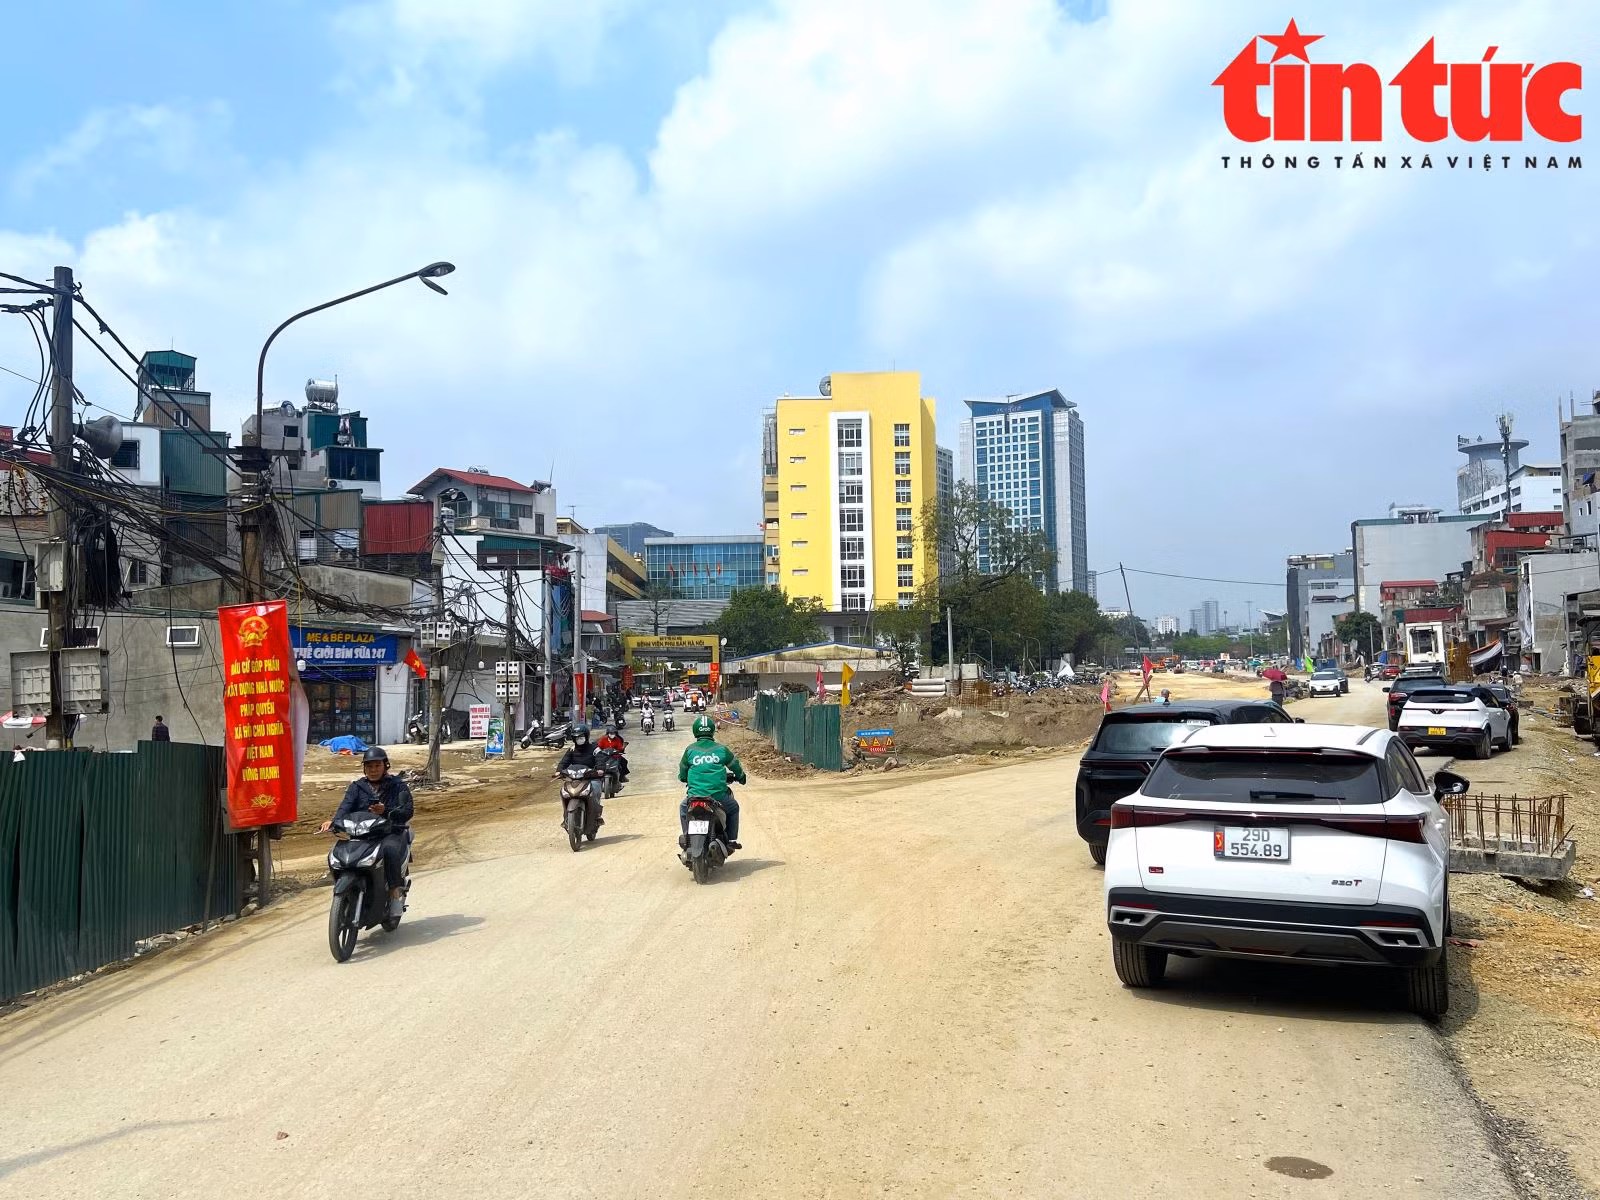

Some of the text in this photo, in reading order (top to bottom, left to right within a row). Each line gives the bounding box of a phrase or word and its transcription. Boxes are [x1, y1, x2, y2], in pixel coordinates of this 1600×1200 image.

[344, 633, 375, 643] PLAZA
[371, 648, 386, 659] 247
[259, 745, 274, 759] NAM
[692, 752, 720, 766] Grab
[1242, 828, 1270, 842] 29D
[1230, 843, 1282, 857] 554.89
